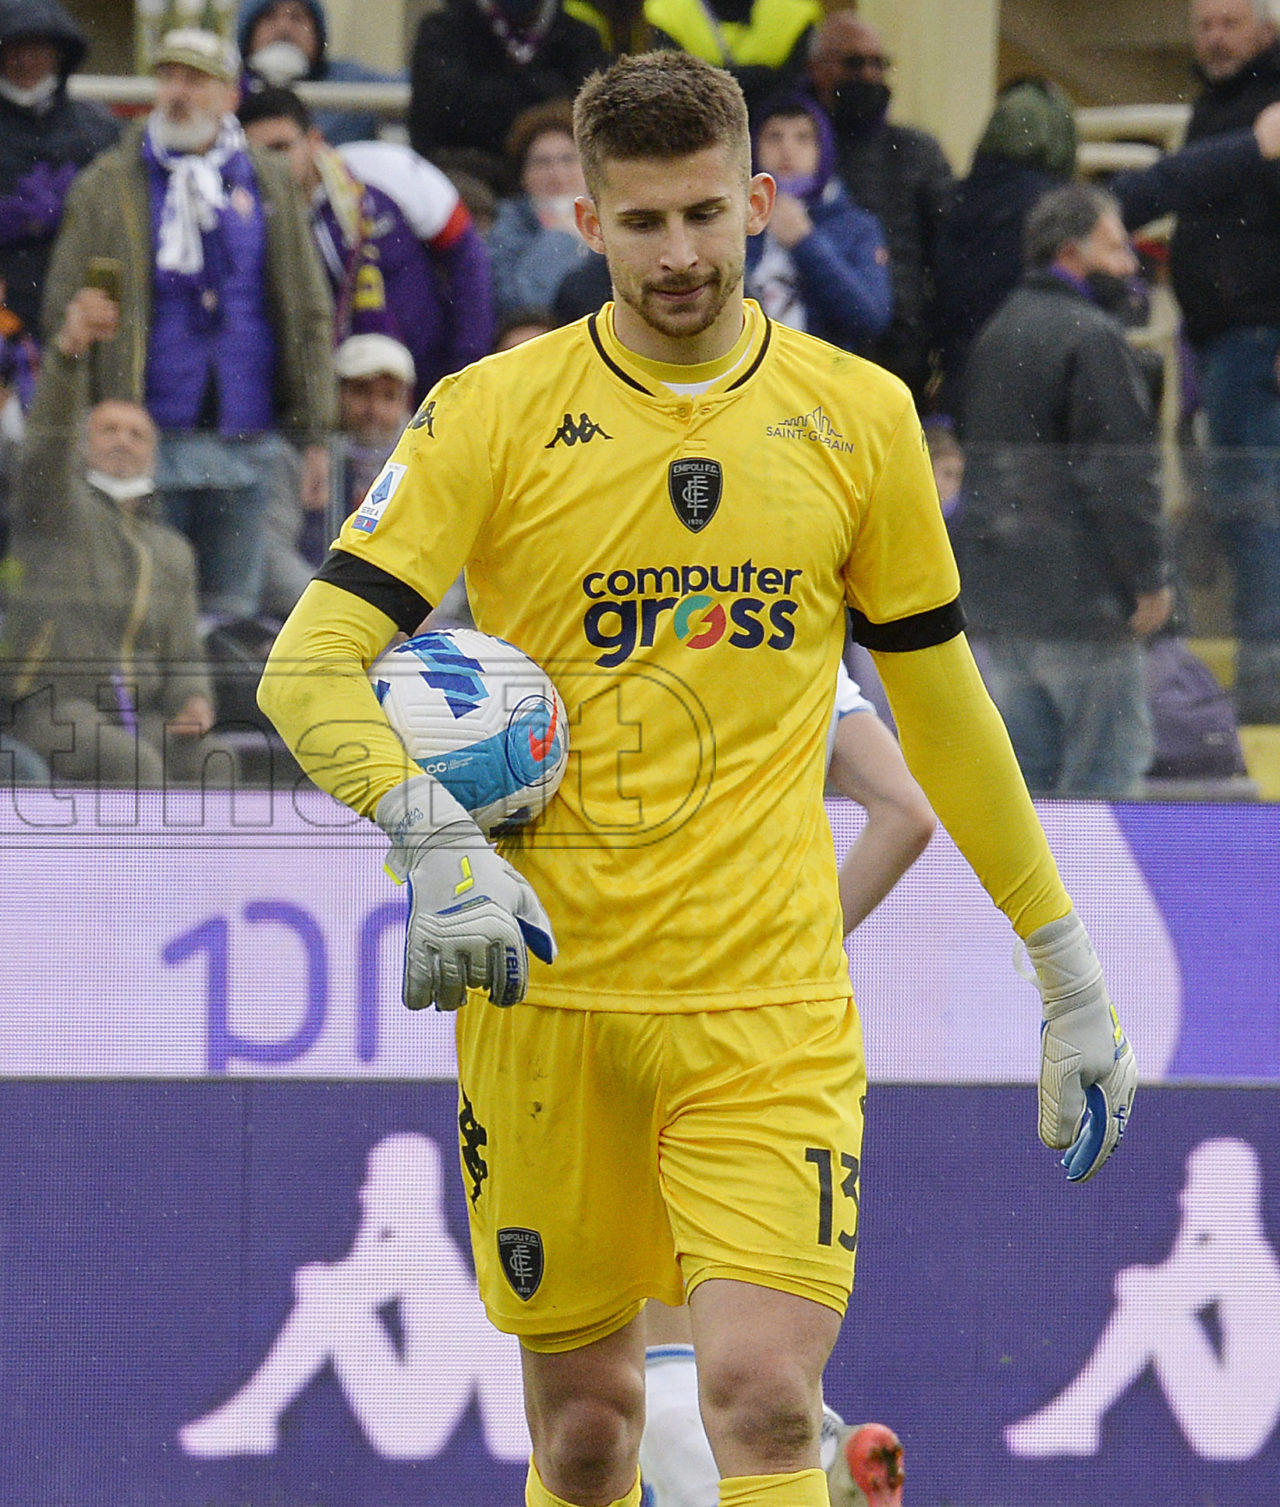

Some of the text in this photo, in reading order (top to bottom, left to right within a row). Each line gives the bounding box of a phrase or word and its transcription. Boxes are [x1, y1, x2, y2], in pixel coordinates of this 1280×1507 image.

[673, 463, 704, 474] EMPOLI
[582, 558, 802, 598] computer
[583, 595, 799, 668] gross
[804, 1146, 861, 1253] 13
